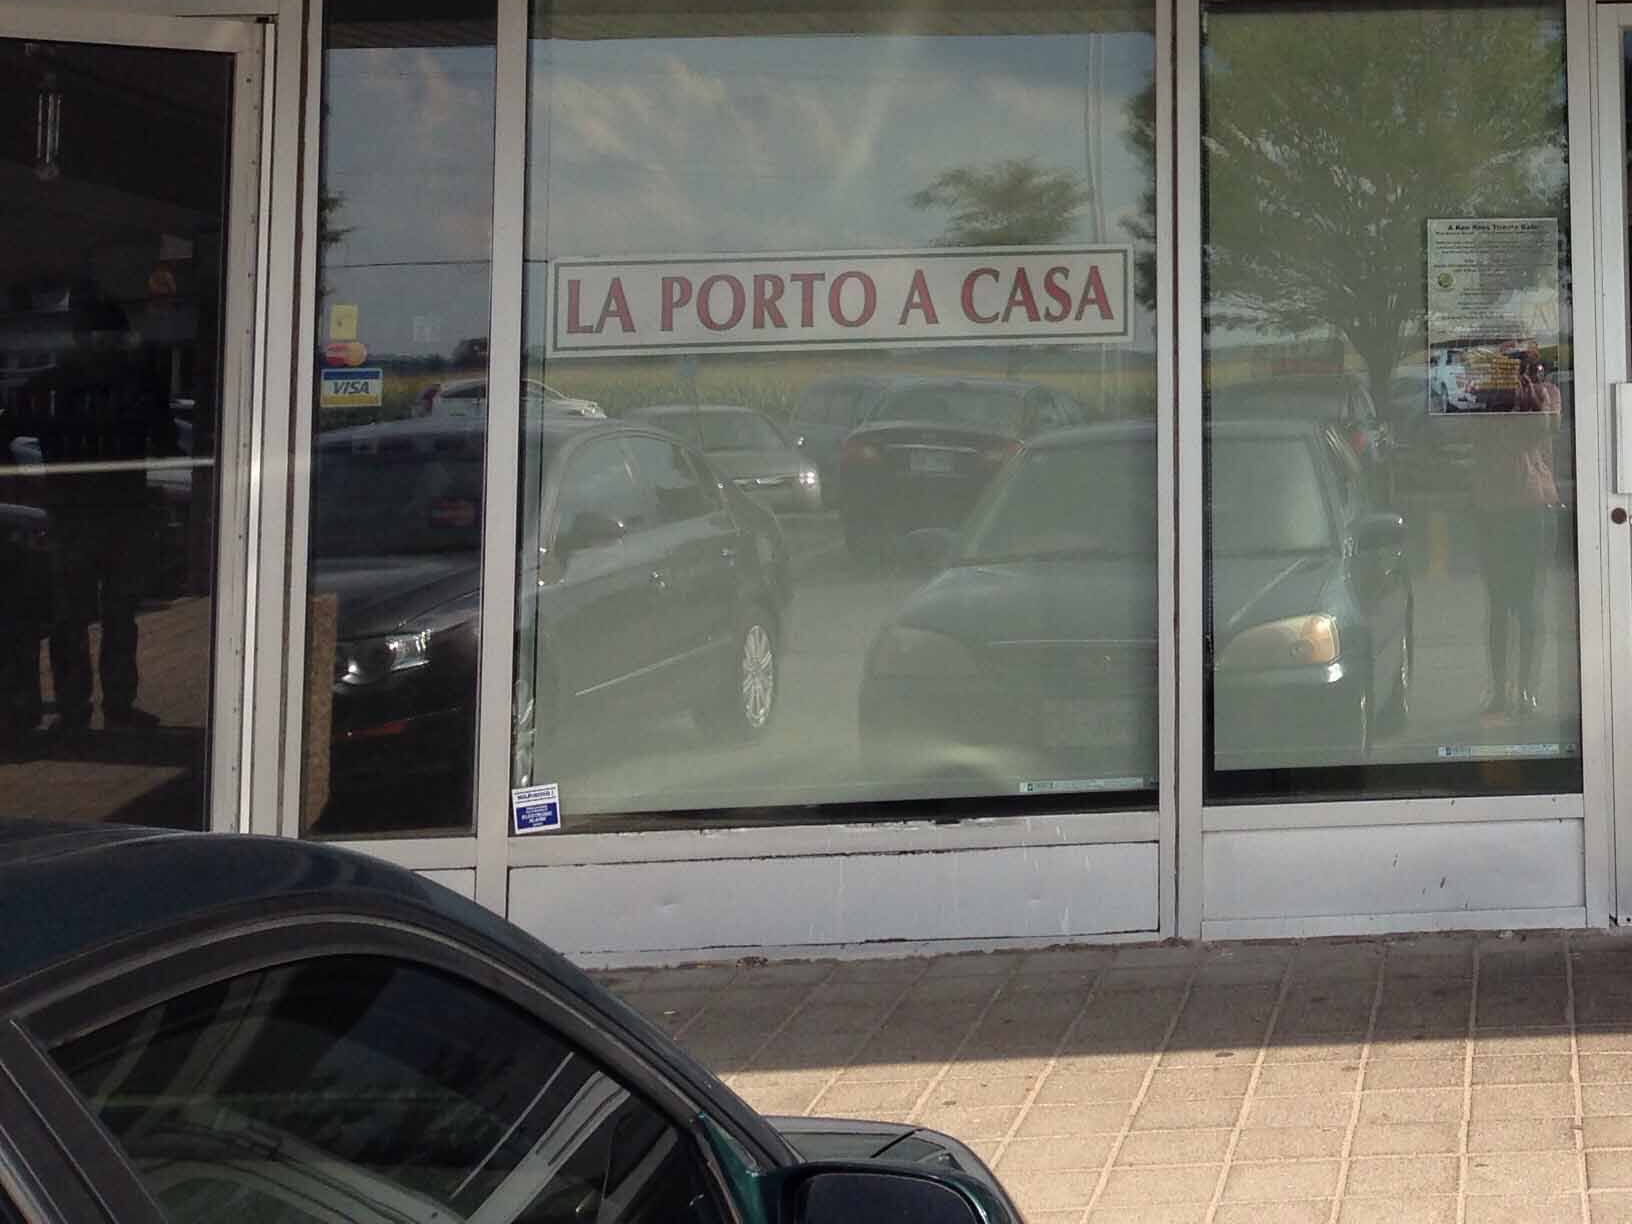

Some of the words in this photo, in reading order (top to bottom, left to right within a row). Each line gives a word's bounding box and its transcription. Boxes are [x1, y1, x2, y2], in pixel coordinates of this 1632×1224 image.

[565, 277, 637, 335] LA
[659, 270, 878, 332] PORTO
[898, 269, 939, 325] A
[960, 265, 1115, 325] CASA
[332, 380, 370, 395] VISA
